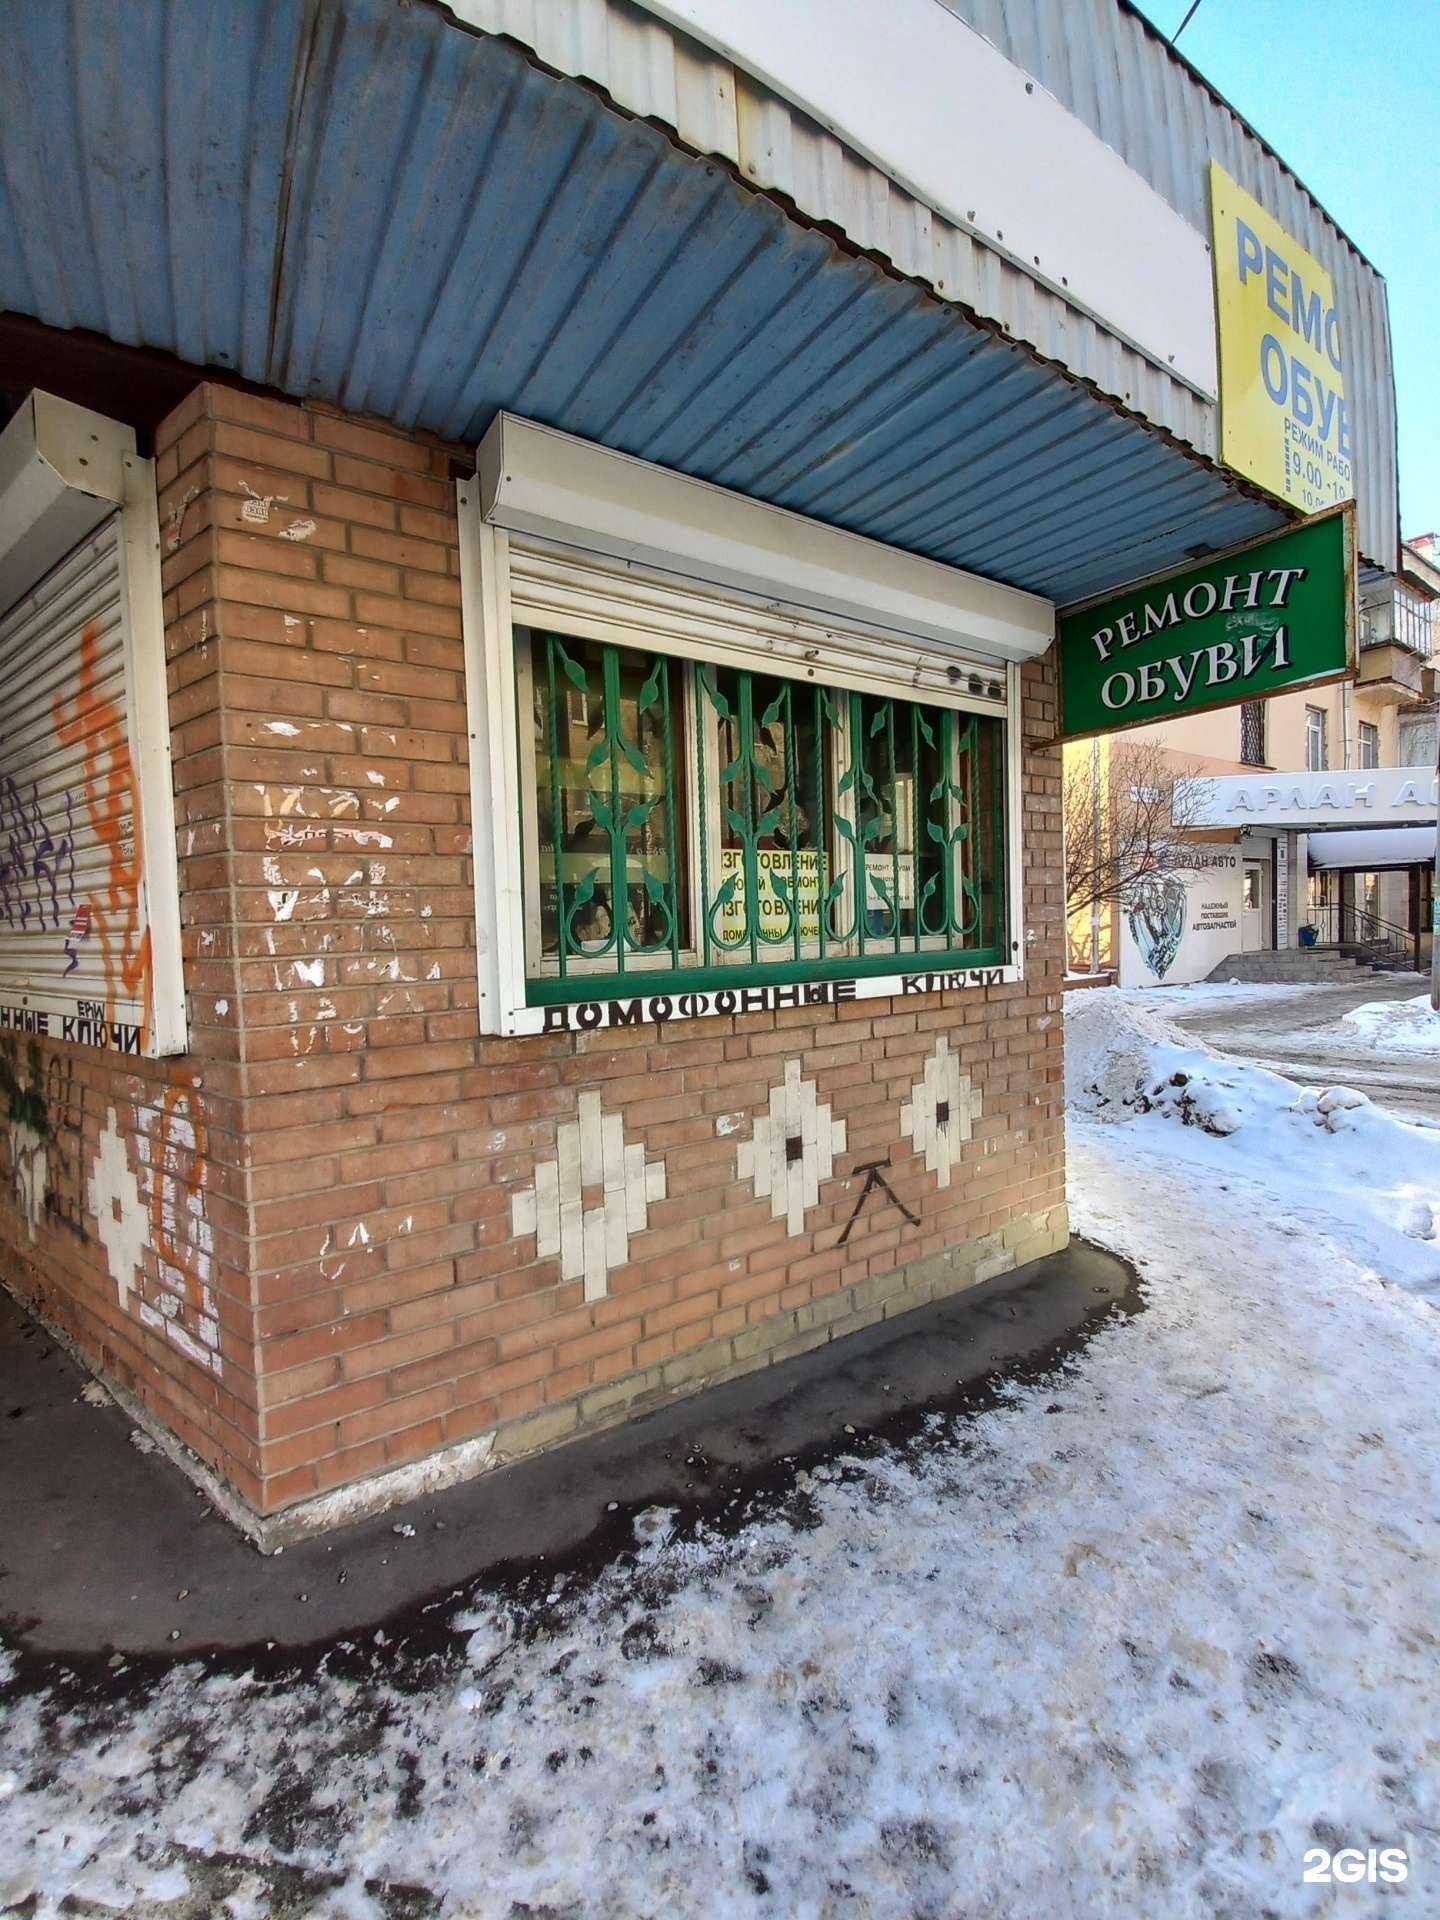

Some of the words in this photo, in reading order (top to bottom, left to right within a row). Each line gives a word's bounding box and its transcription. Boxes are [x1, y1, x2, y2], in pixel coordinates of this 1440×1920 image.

[1285, 417, 1324, 460] РЕЖИМ
[1293, 452, 1322, 490] 9.00
[1091, 568, 1305, 662] РЕМОНТ
[1101, 627, 1290, 710] ОБУВИ
[1226, 781, 1376, 812] АРЛАН
[542, 980, 856, 1033] ДОМОФОННЫЕ
[901, 968, 1004, 994] КЛЮЧИ
[62, 1015, 141, 1056] КЛЮЧИ
